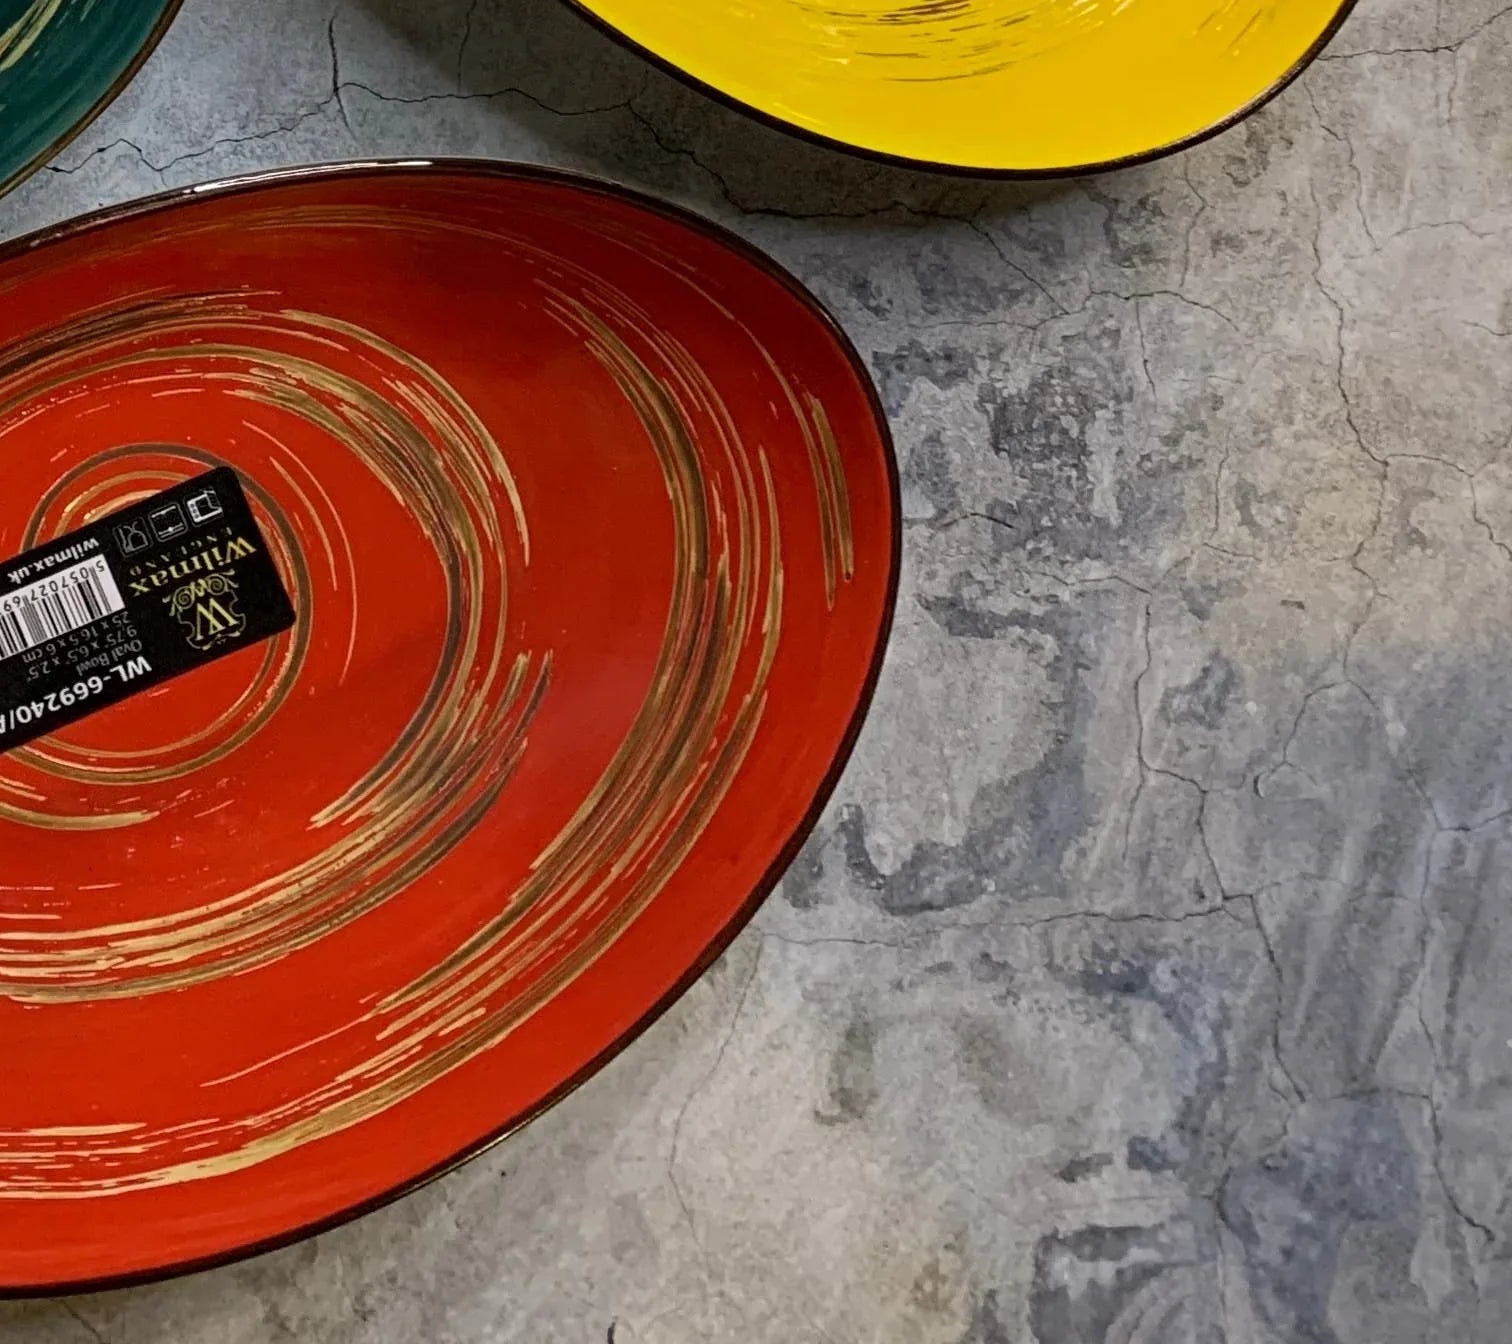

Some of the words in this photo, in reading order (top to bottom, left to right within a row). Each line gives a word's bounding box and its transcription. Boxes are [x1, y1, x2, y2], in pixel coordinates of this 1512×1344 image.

[129, 526, 232, 575] ENGLAND
[7, 537, 99, 583] wilmax.uk
[95, 559, 104, 572] 5
[128, 536, 256, 595] Wilmax
[30, 566, 89, 601] 057027
[98, 619, 108, 629] x
[111, 610, 129, 626] 25
[55, 638, 65, 648] x
[68, 625, 98, 645] 16.5
[45, 643, 55, 655] 6
[89, 640, 98, 650] x
[110, 639, 142, 660] Oval
[21, 648, 42, 662] cm
[50, 656, 60, 667] x
[75, 652, 109, 676] Bowl
